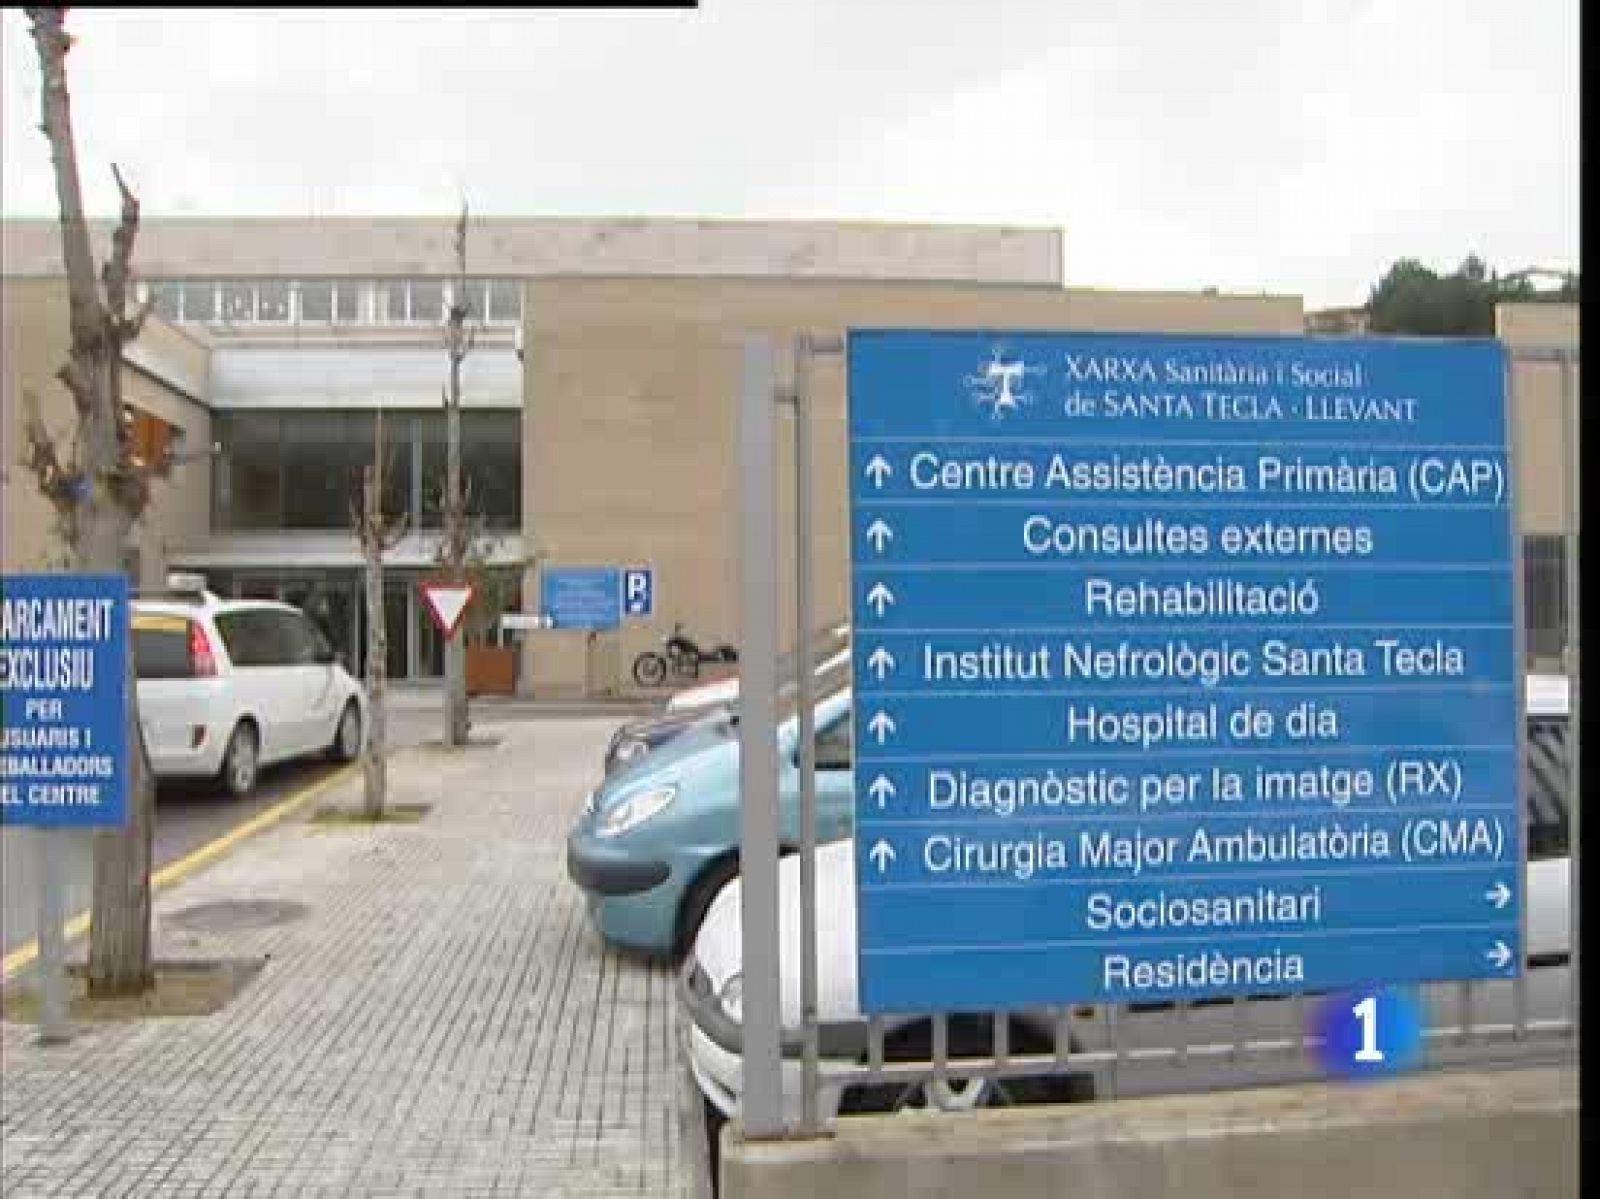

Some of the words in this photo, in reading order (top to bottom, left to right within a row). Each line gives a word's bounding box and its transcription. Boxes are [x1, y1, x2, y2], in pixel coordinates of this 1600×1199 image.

[1066, 355, 1156, 382] XARXA
[1291, 361, 1361, 387] Social
[1065, 390, 1096, 416] de
[1105, 390, 1193, 419] SANTA
[1201, 391, 1283, 419] TECLA
[1305, 395, 1418, 421] LLEVANT
[910, 454, 1033, 489] Centre
[1045, 454, 1246, 492] Assistència
[1259, 457, 1396, 492] Primària
[1408, 457, 1504, 502] (CAP)
[1024, 515, 1209, 553] Consultes
[1222, 521, 1373, 553] externes
[1086, 579, 1318, 615] Rehabilitació
[925, 644, 1050, 679] Institut
[1065, 643, 1250, 689] Nefrològic
[1263, 640, 1365, 675] Santa
[1374, 640, 1463, 675] Tecla
[1068, 704, 1216, 748] Hospital
[1230, 704, 1274, 739] de
[1286, 702, 1338, 736] dia
[931, 769, 1129, 818] Diagnòstic
[1141, 774, 1201, 812] per
[1213, 768, 1242, 800] la
[1257, 766, 1373, 809] imatge
[1387, 762, 1461, 804] (RX)
[925, 832, 1067, 879] Cirurgia
[1080, 829, 1179, 876] Major
[1187, 823, 1390, 861] Ambulatòria
[1402, 818, 1502, 861] (CMA)
[1088, 886, 1321, 929] Sociosanitari
[1105, 949, 1303, 989] Residència
